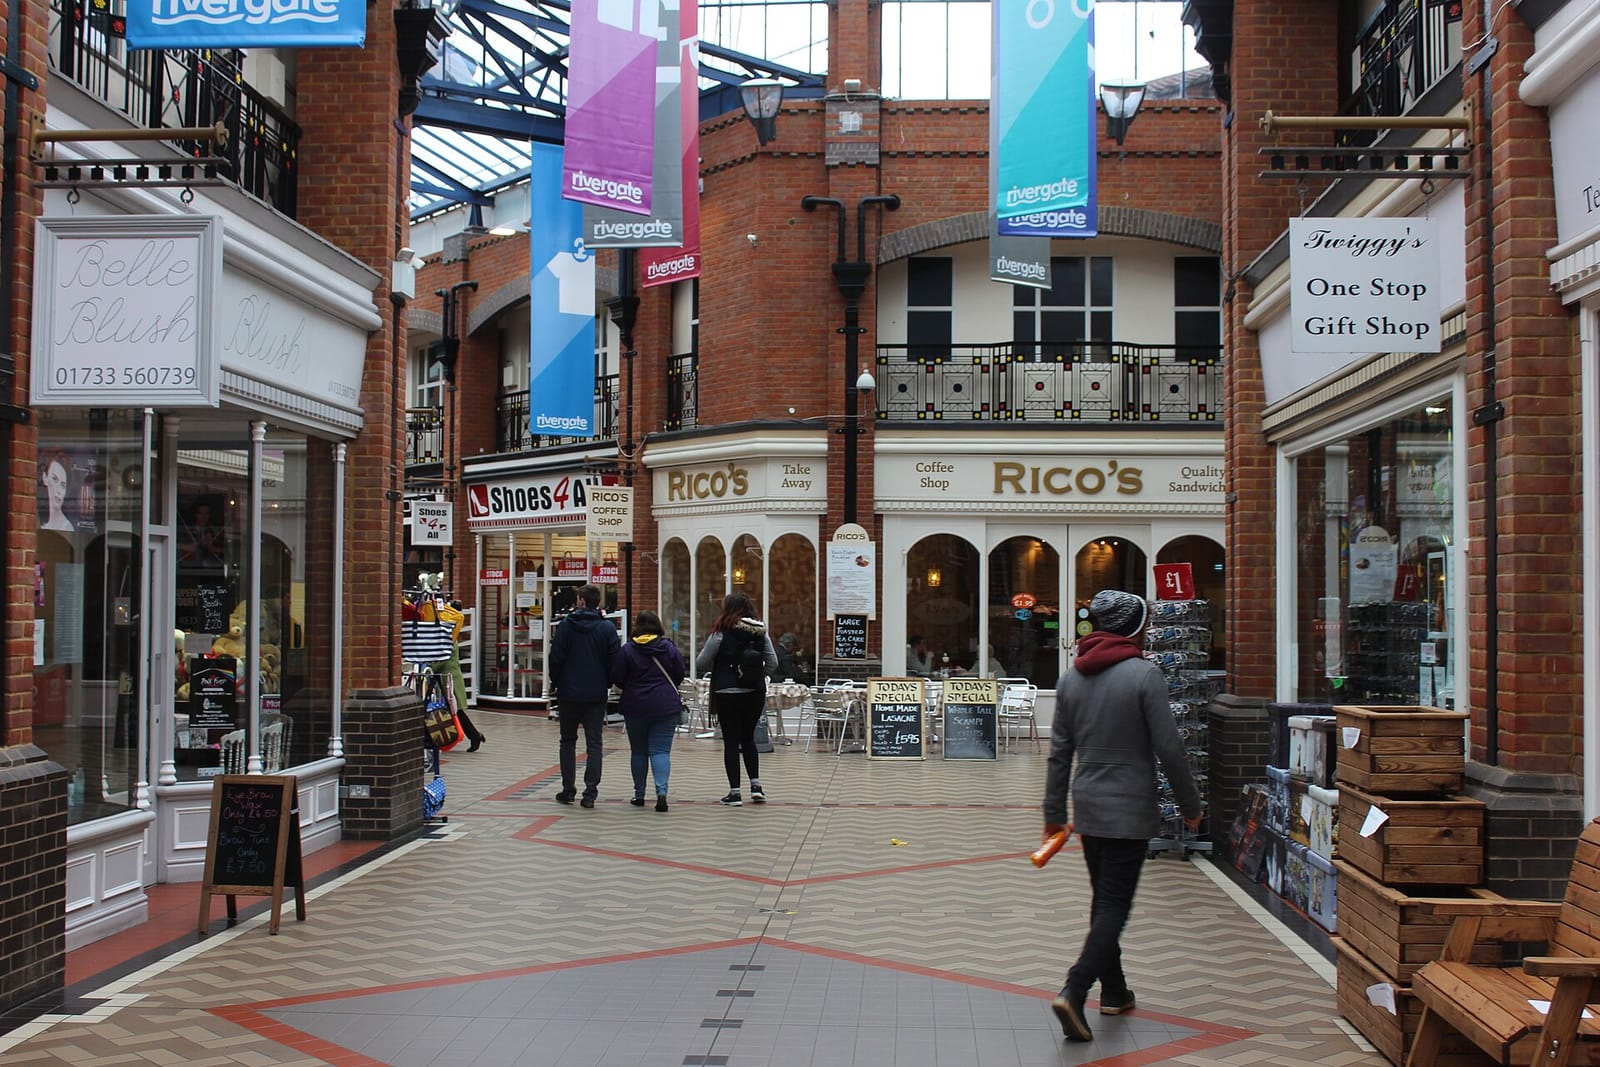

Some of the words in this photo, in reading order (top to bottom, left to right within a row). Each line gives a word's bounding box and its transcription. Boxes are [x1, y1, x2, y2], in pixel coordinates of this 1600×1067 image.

[572, 170, 642, 203] rivergate
[1007, 177, 1078, 206] rivergate
[594, 219, 672, 238] rivergate
[1304, 227, 1428, 257] Twiggy's
[61, 239, 194, 288] Belle
[648, 254, 695, 279] rivergate
[997, 256, 1046, 280] rivergate
[1307, 278, 1361, 296] One
[1370, 278, 1427, 301] Stop
[55, 295, 196, 345] Blush
[224, 294, 305, 374] Blush
[1305, 316, 1357, 335] Gift
[1366, 316, 1430, 340] Shop
[56, 367, 116, 385] 01733
[122, 367, 196, 385] 560739
[536, 413, 588, 430] rivergate
[782, 464, 811, 475] Take
[915, 461, 954, 473] Coffee
[1181, 465, 1225, 479] Quality
[668, 462, 748, 501] RICO'S
[920, 476, 950, 491] Shop
[993, 460, 1143, 495] RICO'S
[781, 478, 812, 491] Away
[592, 492, 629, 502] RICO'S
[419, 507, 447, 517] Shoes
[592, 506, 629, 515] COFFEE
[428, 518, 439, 530] 4
[597, 517, 623, 526] SHOP
[427, 531, 439, 539] All
[565, 561, 585, 569] STOCK
[486, 570, 503, 578] STOCK
[558, 569, 587, 577] CLEARANC
[1166, 572, 1184, 594] £1
[838, 617, 861, 626] LARGE
[876, 682, 917, 692] TODAYS
[950, 682, 992, 691] TODAYS
[875, 693, 918, 702] SPECIAL
[948, 693, 993, 703] SPECIAL
[875, 704, 895, 712] HOME
[881, 713, 918, 722] LASAGNE
